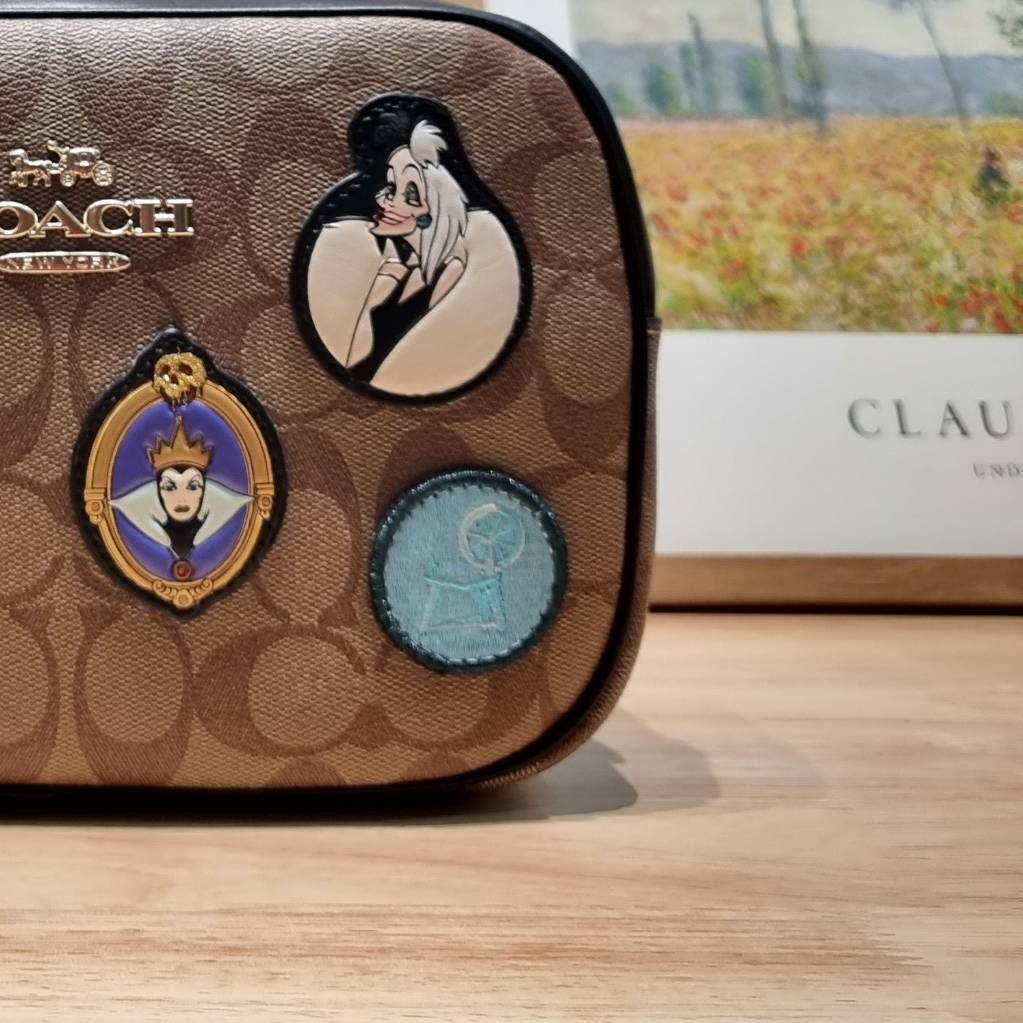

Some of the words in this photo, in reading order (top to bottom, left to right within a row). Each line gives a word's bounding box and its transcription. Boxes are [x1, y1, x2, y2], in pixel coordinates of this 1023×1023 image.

[5, 255, 54, 270] NEW
[61, 255, 120, 270] YORK
[847, 397, 1012, 440] CLAU
